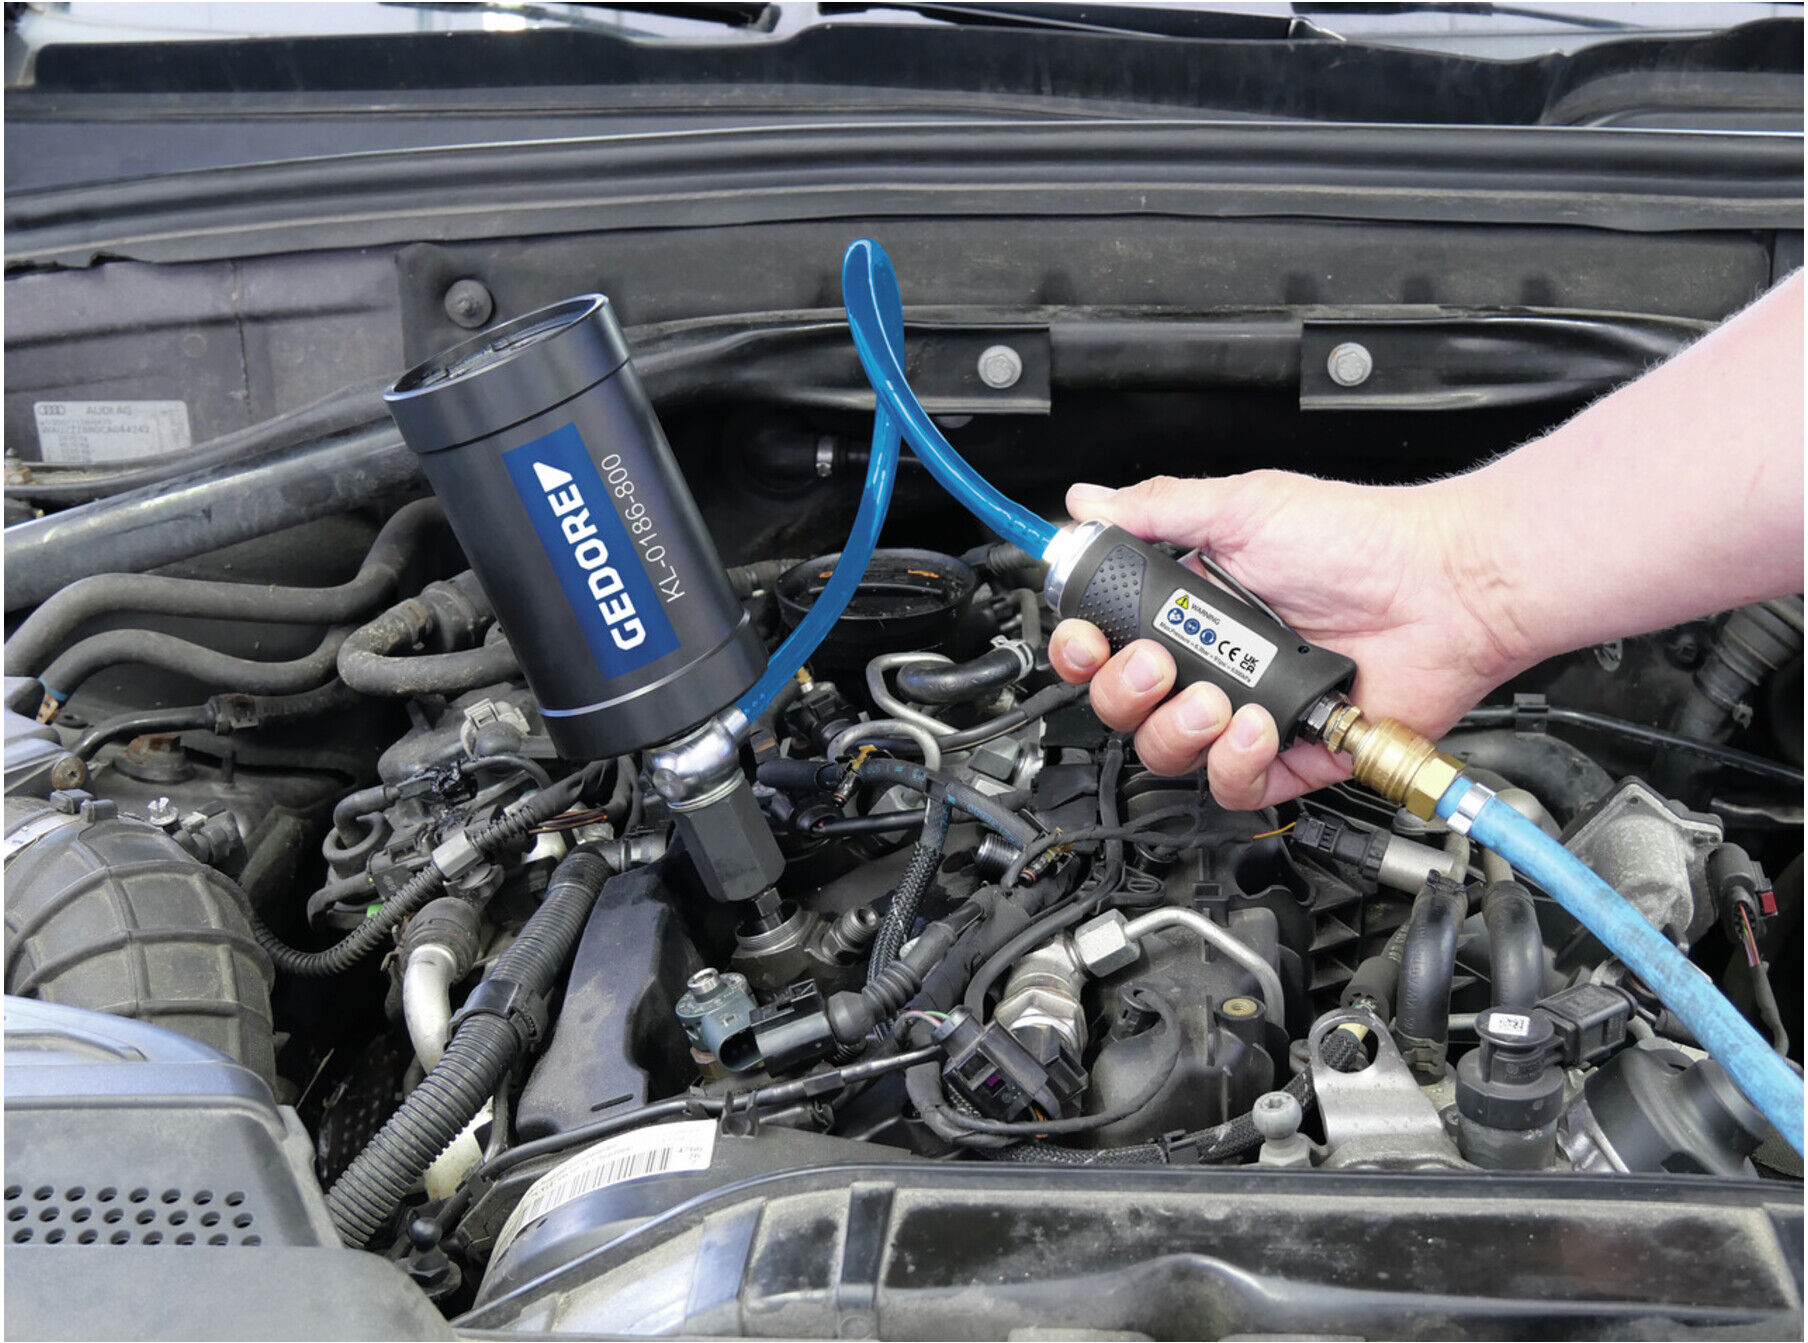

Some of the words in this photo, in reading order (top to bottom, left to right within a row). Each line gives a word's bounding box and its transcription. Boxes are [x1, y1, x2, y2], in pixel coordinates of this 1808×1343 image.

[86, 406, 113, 415] AUDI
[116, 406, 132, 415] AG
[600, 453, 686, 603] KL-0186-800
[547, 483, 647, 651] GEDORE
[1192, 604, 1221, 626] WARNING
[1244, 654, 1259, 667] UK
